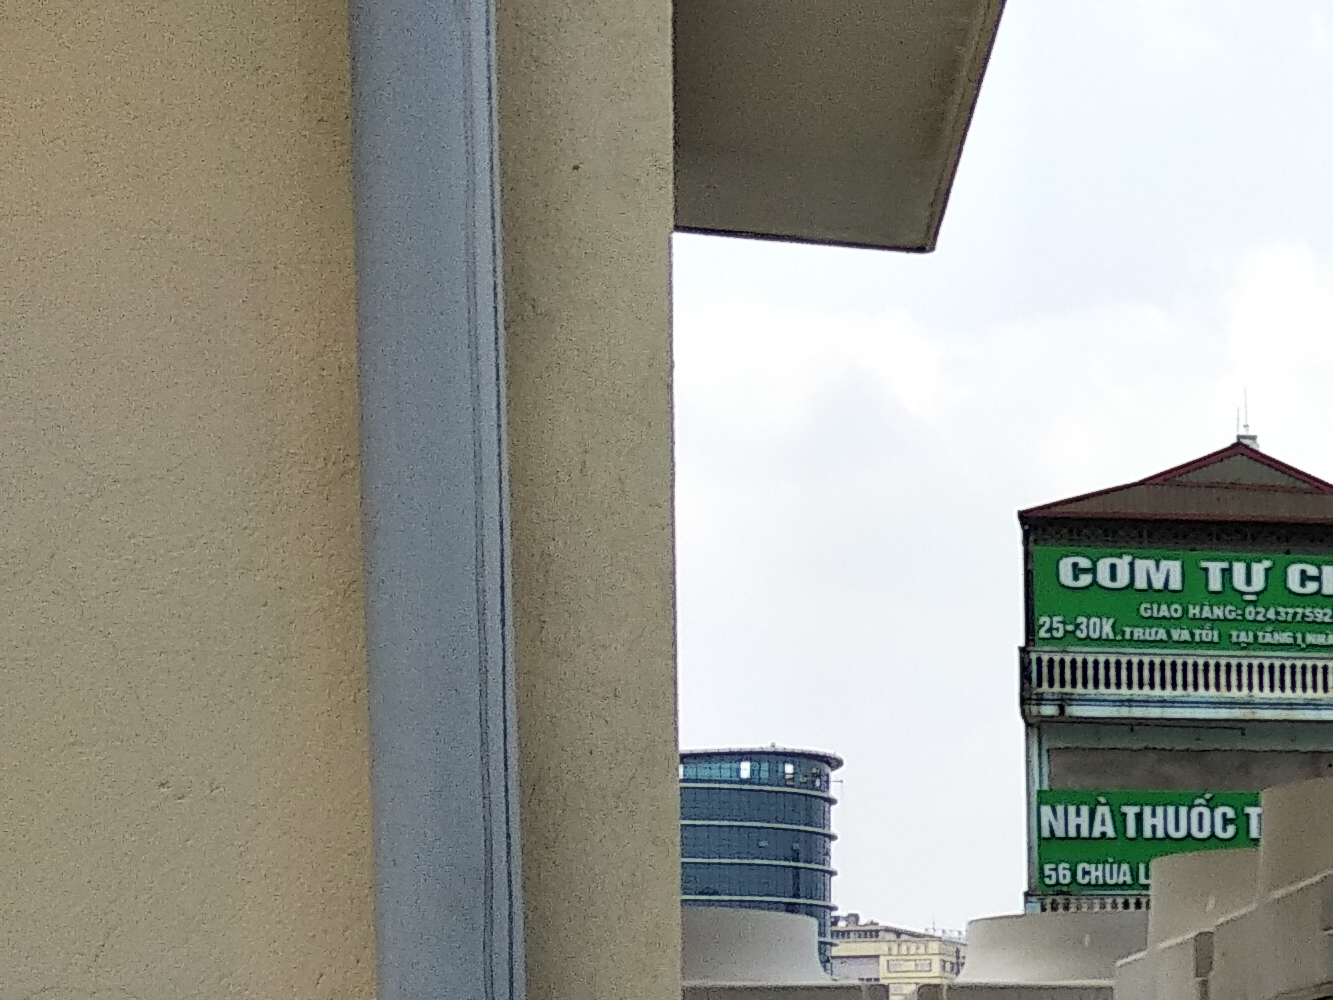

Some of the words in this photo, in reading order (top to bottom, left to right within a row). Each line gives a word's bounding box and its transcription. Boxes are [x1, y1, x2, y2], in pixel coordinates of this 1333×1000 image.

[1058, 554, 1183, 592] CƠM
[1200, 559, 1272, 601] TỰ
[1139, 603, 1183, 618] GIAO
[1040, 796, 1117, 838] NHÀ
[1121, 792, 1237, 839] THUỐC
[1244, 806, 1263, 838] T
[1043, 862, 1072, 885] 56
[1076, 858, 1132, 885] CHÙA
[1138, 862, 1151, 885] L
